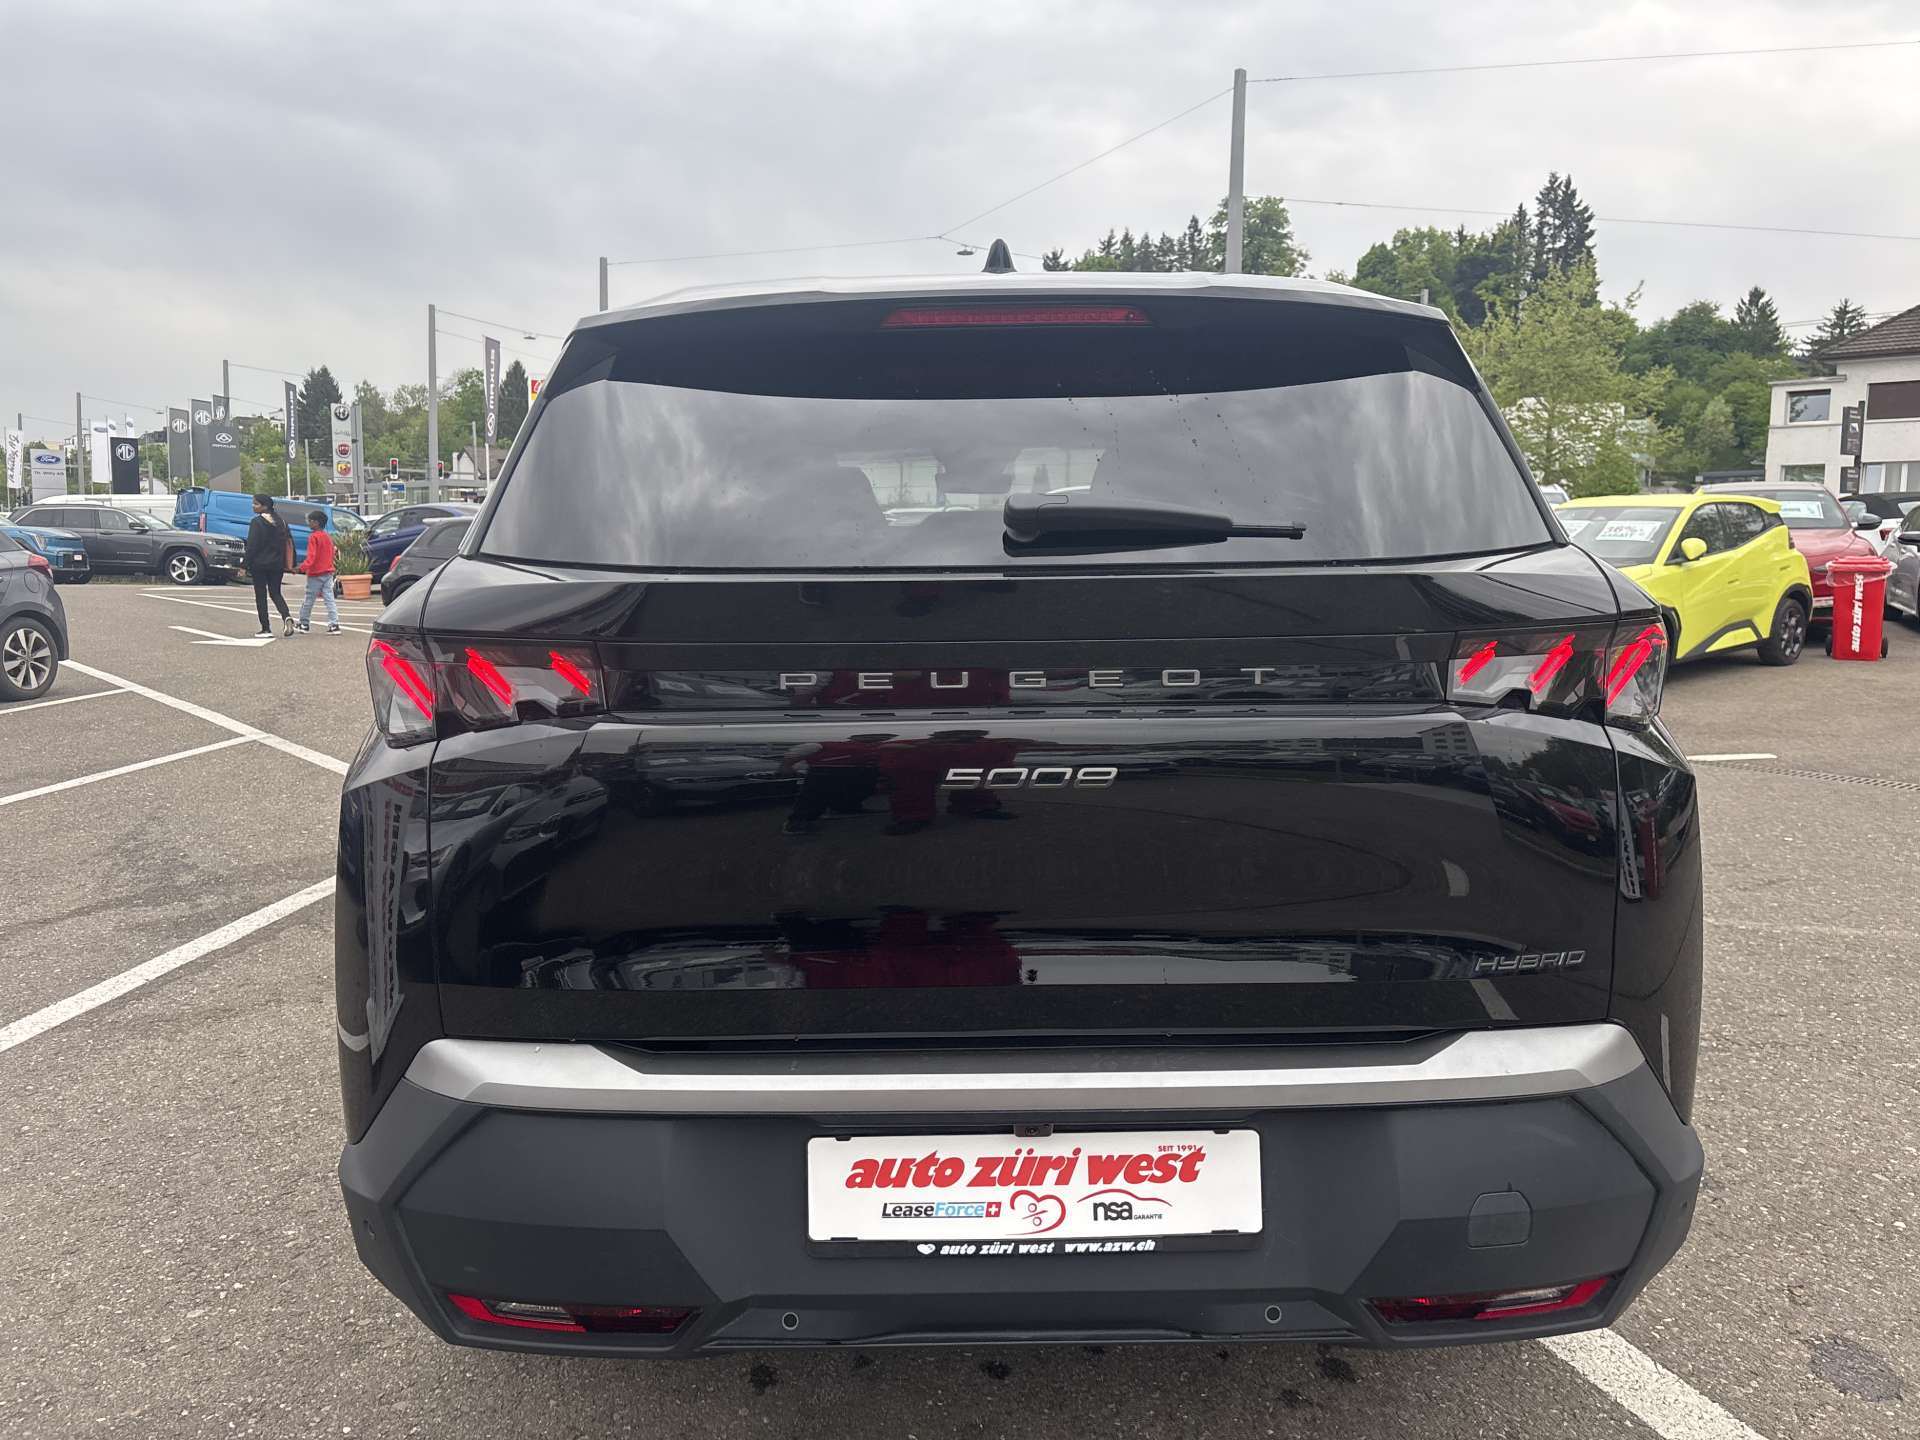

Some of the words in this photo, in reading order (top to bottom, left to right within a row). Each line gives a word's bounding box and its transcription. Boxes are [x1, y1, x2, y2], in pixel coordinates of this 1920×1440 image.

[172, 419, 187, 433] MG
[195, 410, 211, 425] MG
[115, 443, 135, 461] MG
[1851, 625, 1861, 652] auto
[779, 668, 1276, 690] PEUGEOT
[940, 768, 1118, 789] 5008
[1475, 950, 1586, 971] HYBRID
[1176, 1144, 1197, 1152] 1991
[845, 1150, 965, 1188] auto
[966, 1147, 1082, 1187] züri
[1087, 1145, 1205, 1185] west
[881, 1202, 985, 1218] LeaseForce
[1093, 1201, 1133, 1221] nsa
[940, 1243, 976, 1255] auto
[980, 1241, 1014, 1255] züri
[1018, 1242, 1055, 1254] west
[1064, 1239, 1156, 1253] www.azw.ch
